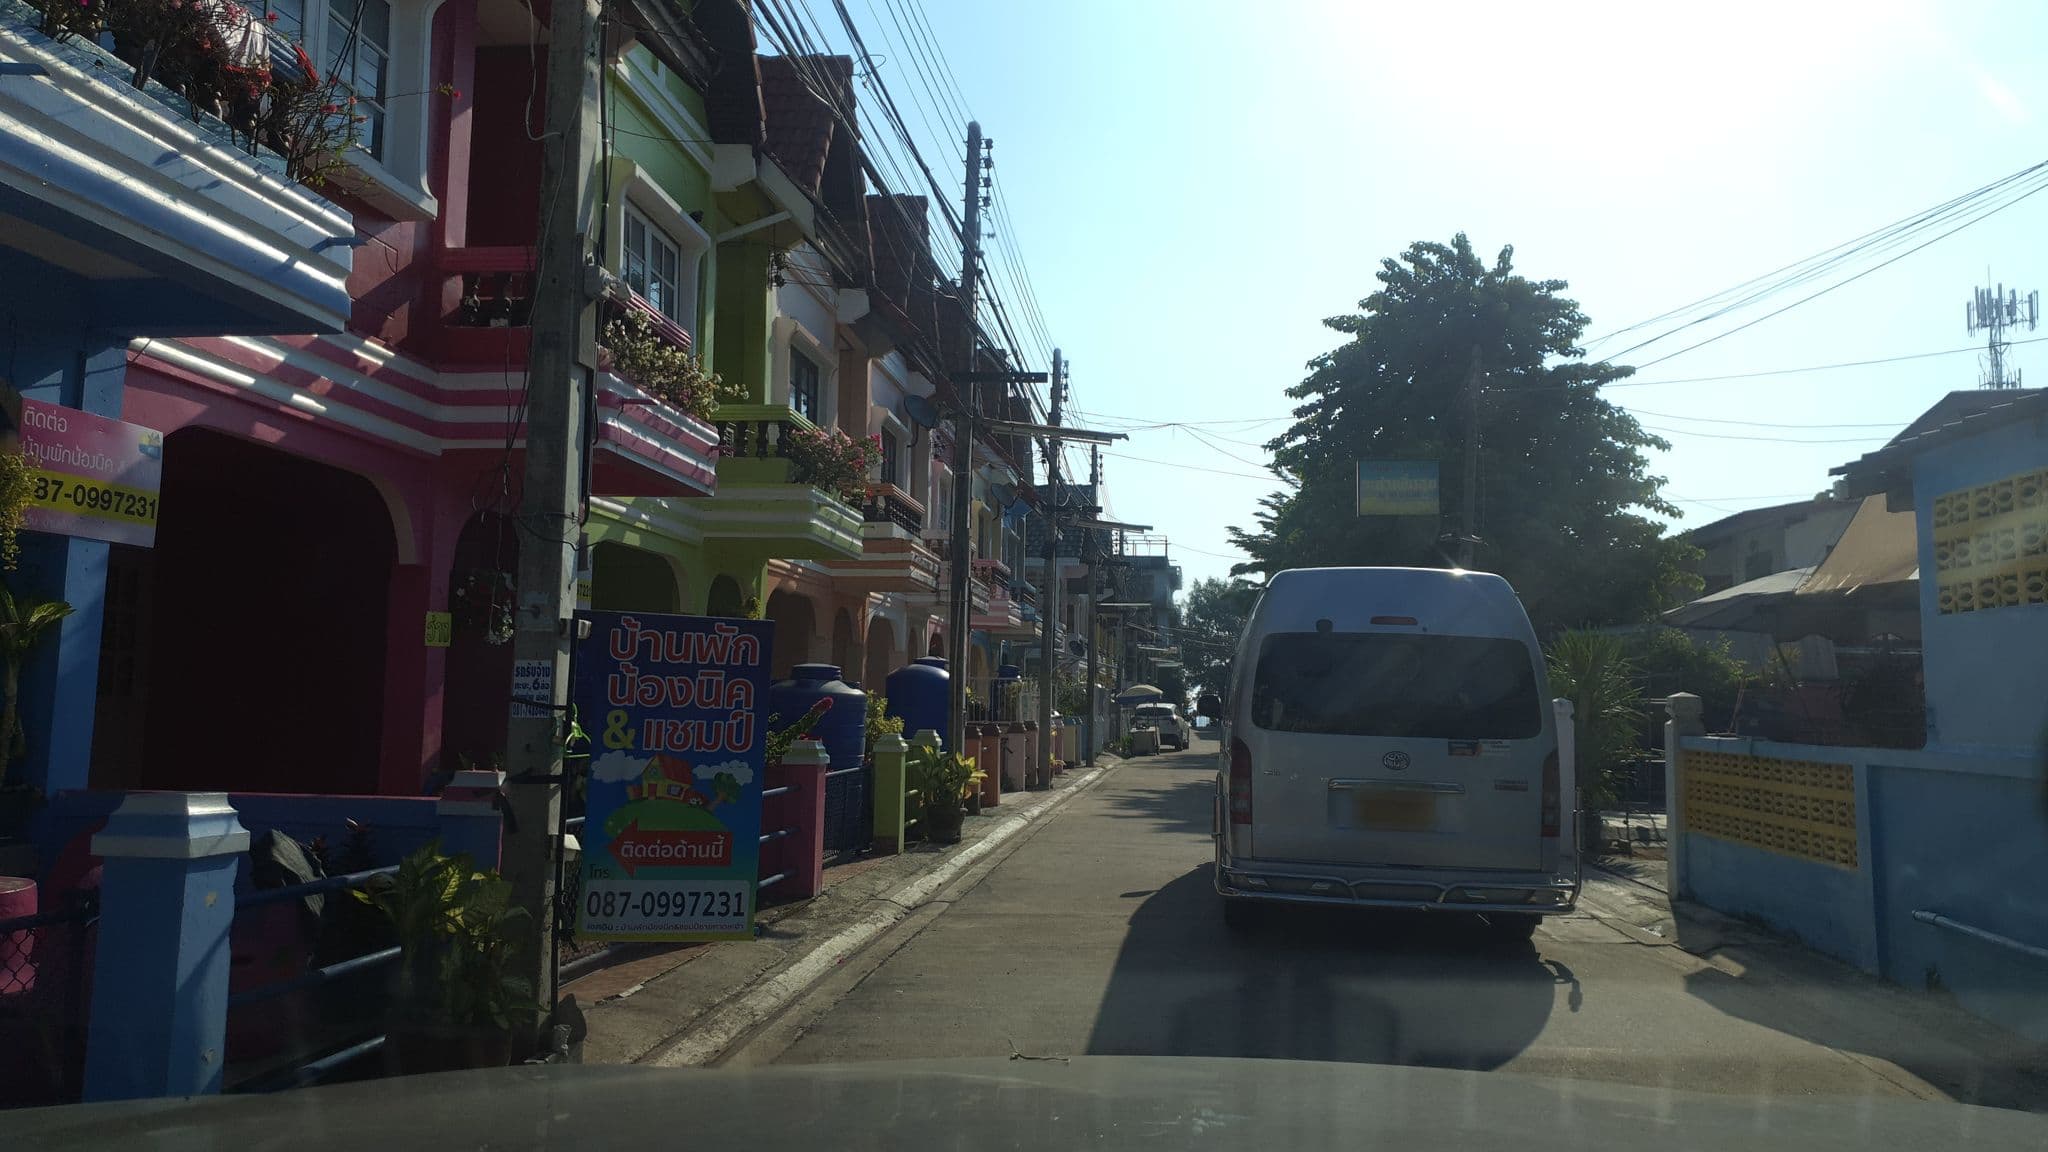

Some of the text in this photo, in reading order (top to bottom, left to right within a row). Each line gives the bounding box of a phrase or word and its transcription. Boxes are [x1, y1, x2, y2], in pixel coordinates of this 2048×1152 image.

[24, 406, 68, 433] ติดต่อ
[34, 477, 156, 520] 87-0997231
[609, 616, 759, 666] บ้านพัก
[608, 663, 755, 710] น้องนิค
[603, 709, 756, 754] & แชมป์
[620, 834, 725, 860] ติดต่อด้านนี้
[586, 890, 746, 918] 087-0997231
